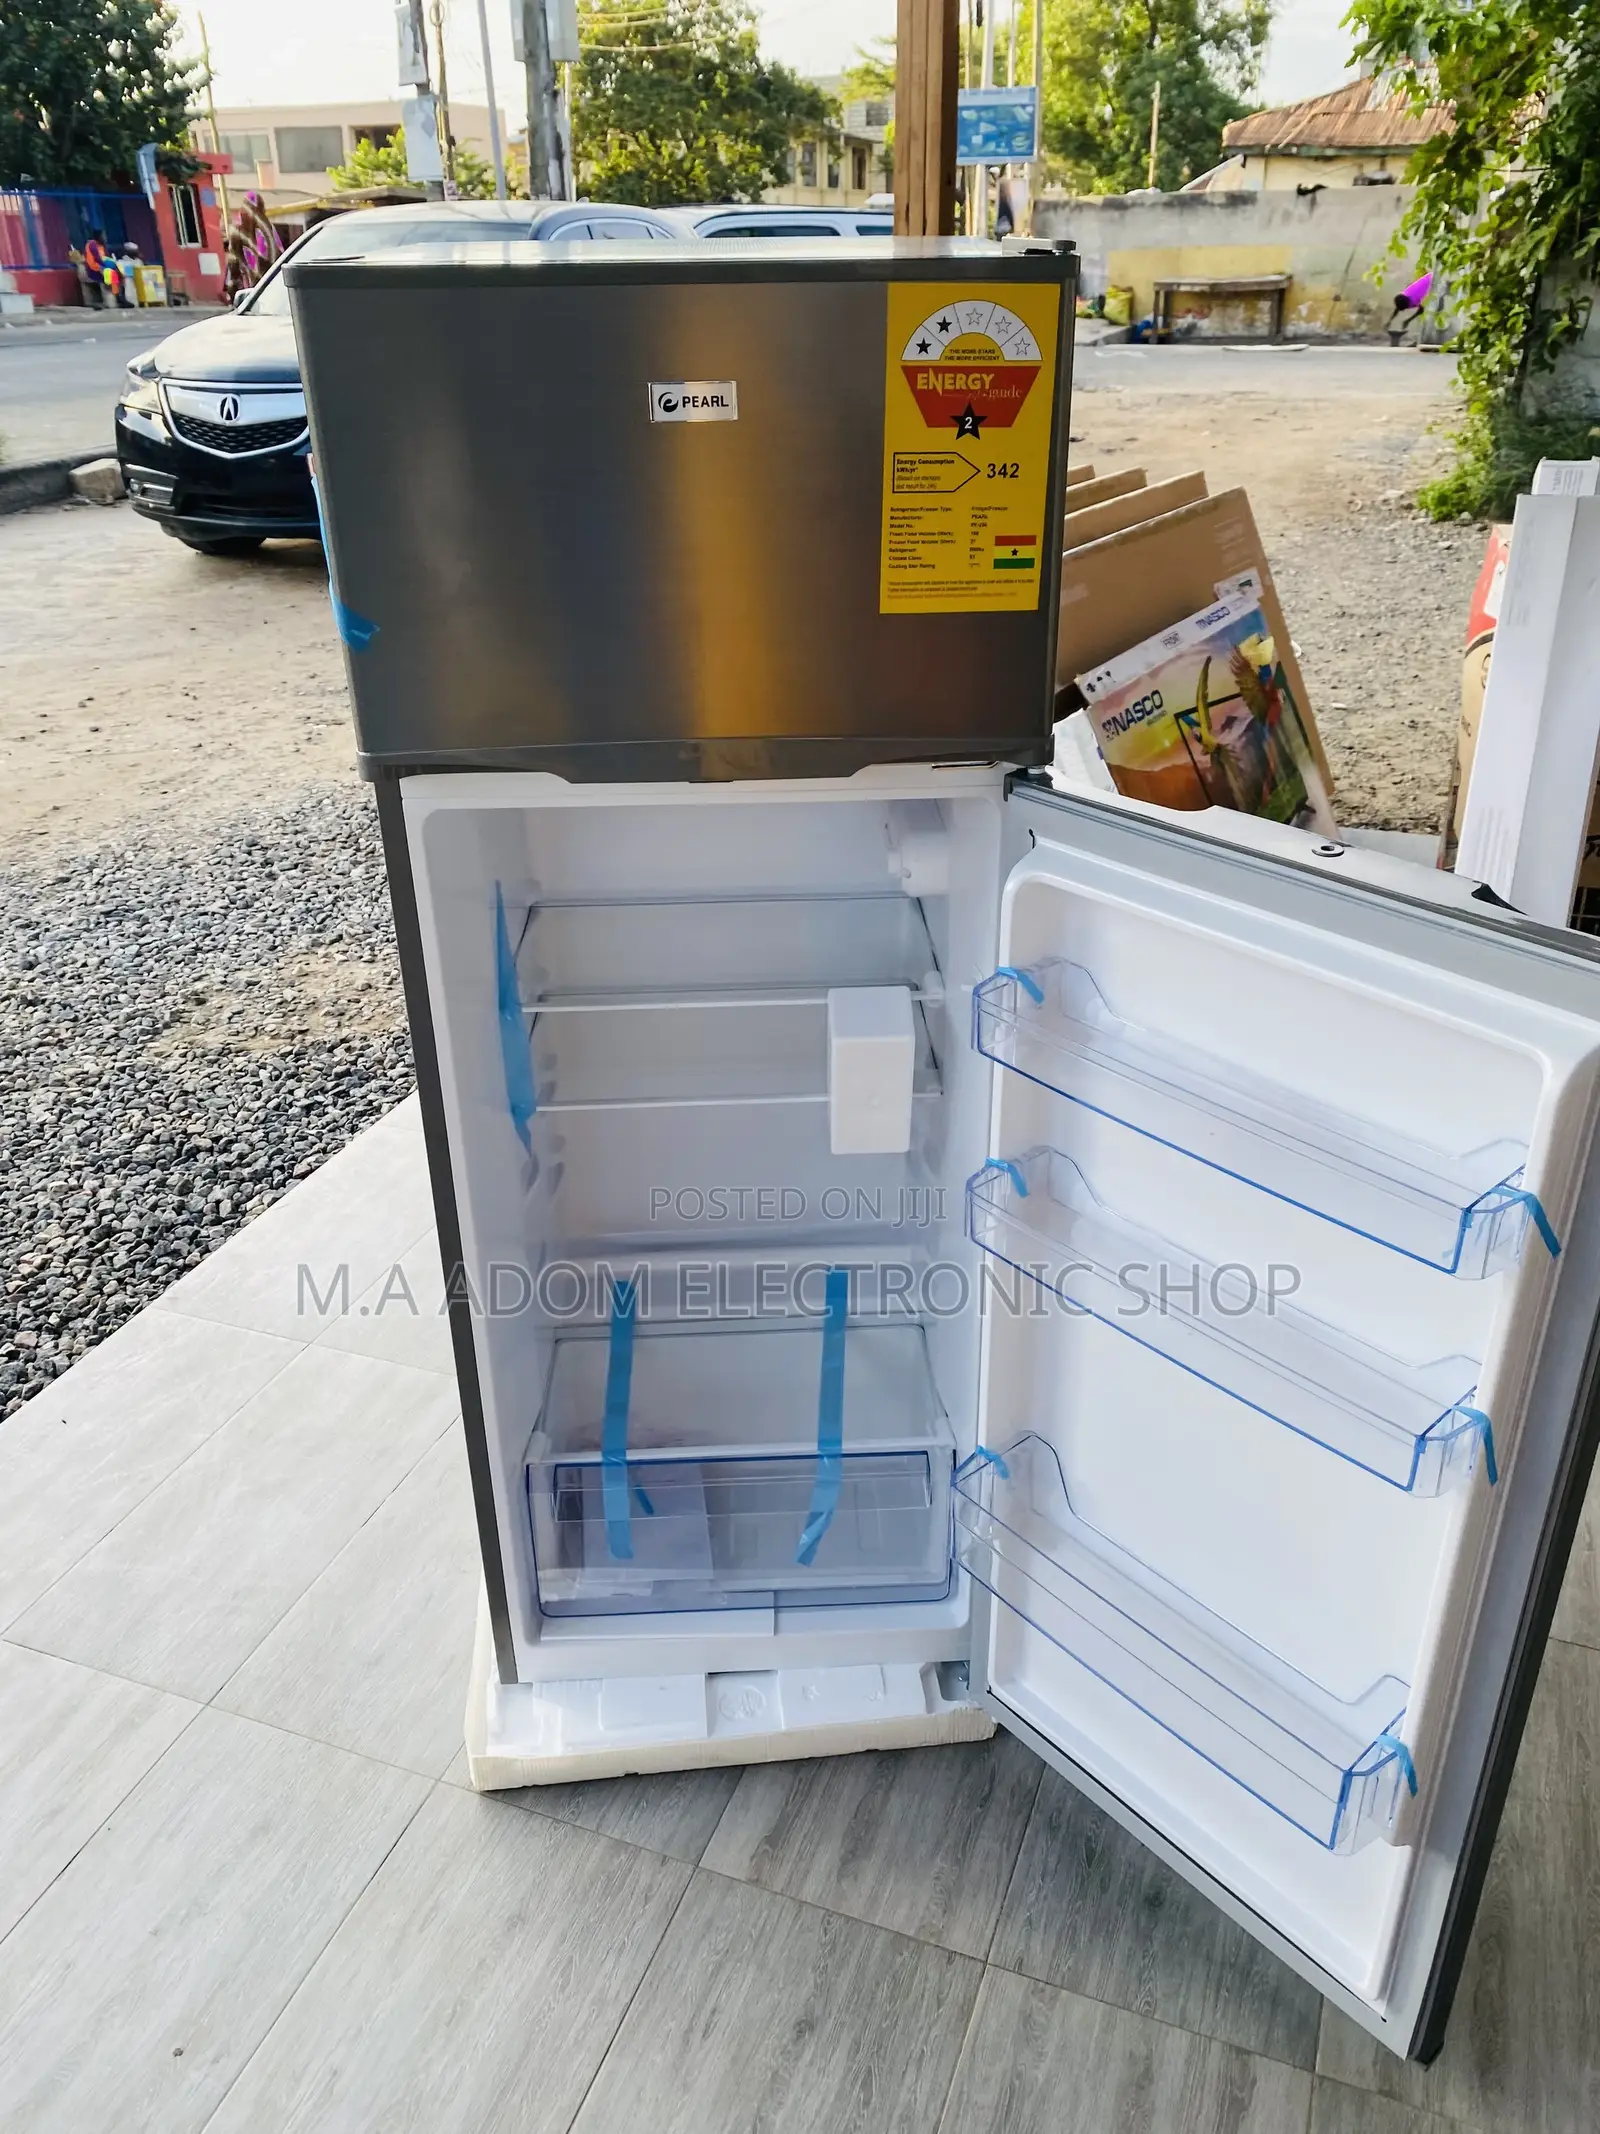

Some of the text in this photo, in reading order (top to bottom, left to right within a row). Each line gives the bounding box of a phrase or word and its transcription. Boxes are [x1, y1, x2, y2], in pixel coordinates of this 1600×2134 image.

[917, 368, 995, 396] ENERGY
[682, 395, 729, 408] PEARL
[964, 416, 973, 429] 2
[987, 463, 1020, 479] 342
[1111, 689, 1165, 736] NASCO
